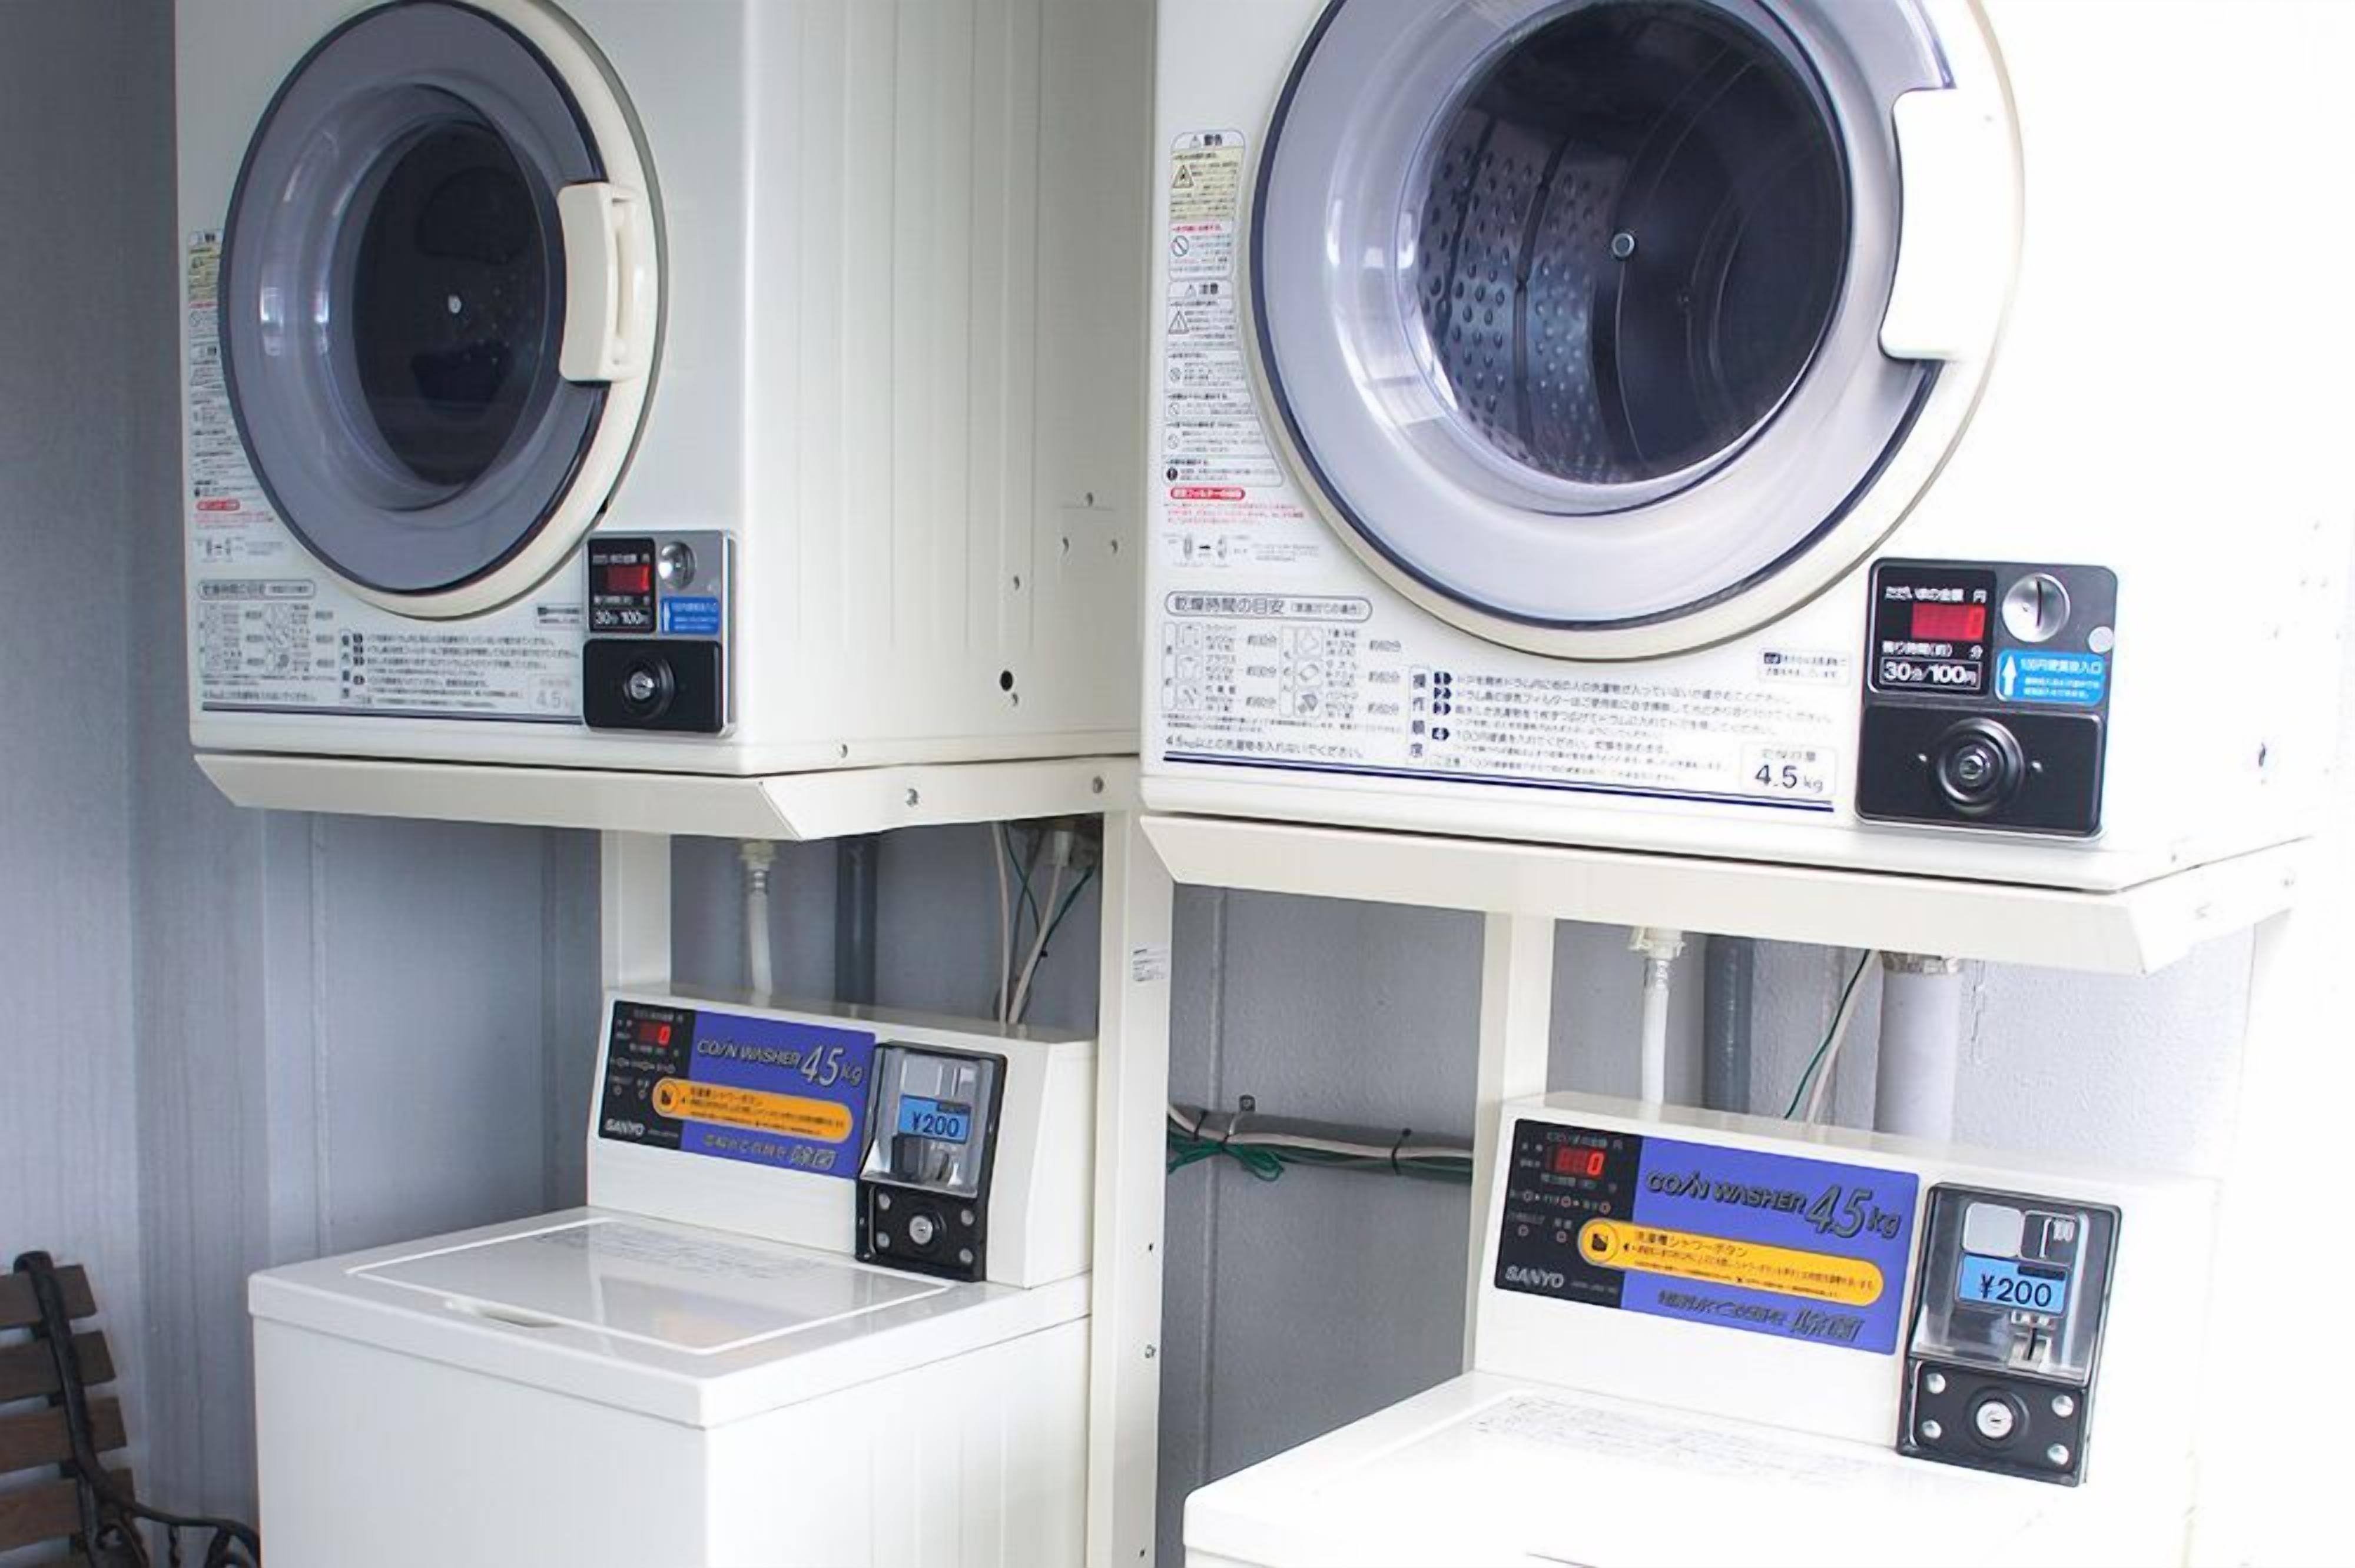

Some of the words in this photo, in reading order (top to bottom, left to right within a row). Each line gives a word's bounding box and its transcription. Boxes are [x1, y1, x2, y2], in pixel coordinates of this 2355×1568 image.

[605, 1119, 645, 1137] SANYO
[1587, 1151, 1606, 1176] 0
[1505, 1265, 1564, 1288] SANYO
[1980, 1274, 2052, 1307] ¥200
